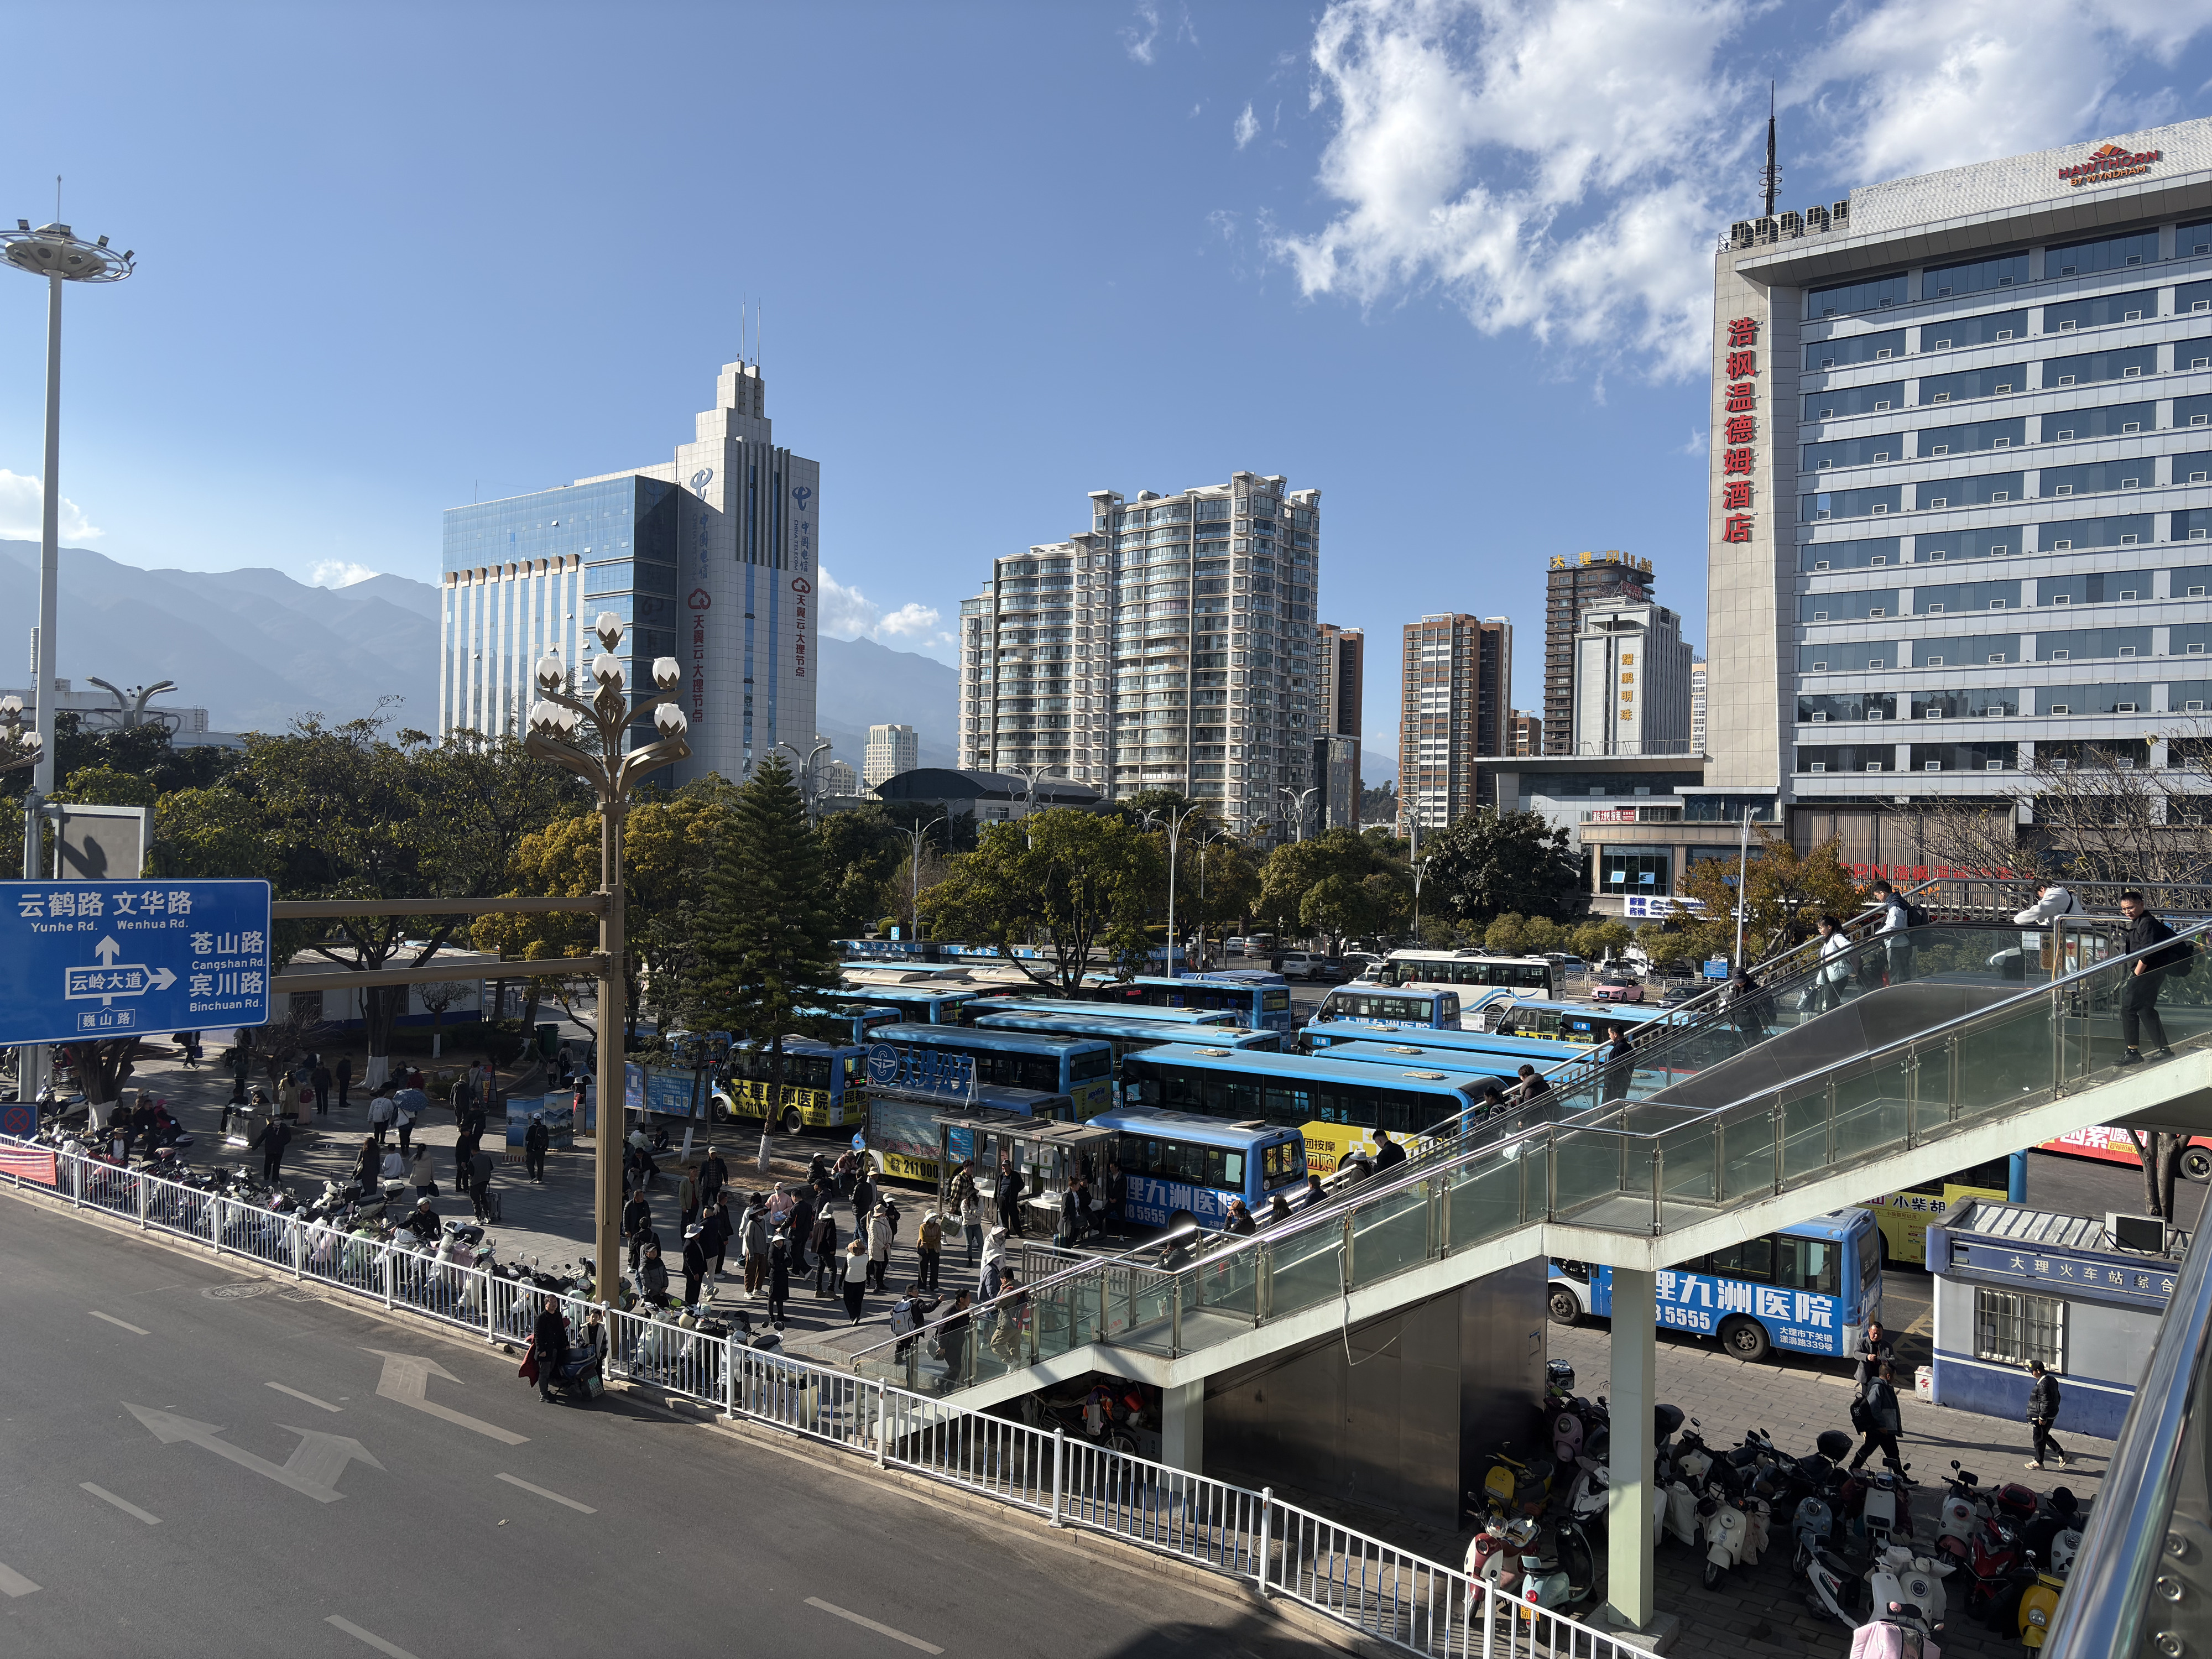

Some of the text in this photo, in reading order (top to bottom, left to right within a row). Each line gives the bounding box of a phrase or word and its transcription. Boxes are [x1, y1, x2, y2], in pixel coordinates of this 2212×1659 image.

[2059, 150, 2158, 179] HAWTHORN
[2070, 165, 2146, 186] BY WYNDHAM
[1722, 317, 1755, 542] 浩枫温德姆酒店
[1621, 653, 1634, 721] 耀鹏明珠
[18, 891, 192, 917] 云鹤路 文华路
[31, 919, 189, 932] Yunhe Rd. Wenhua Rd.
[190, 931, 264, 954] 苍山路
[192, 958, 265, 971] Cangshan Rd.
[71, 972, 142, 992] 云岭大道
[189, 972, 264, 997] 宾川路
[190, 999, 263, 1012] Binchuan Rd.
[83, 1013, 130, 1027] 巍山路
[901, 1045, 973, 1097] 大理公交
[745, 1102, 770, 1115] 21100
[1137, 1206, 1166, 1224] 5555
[1893, 1196, 1945, 1214] 小柴胡
[1665, 1306, 1710, 1329] 5555
[1780, 1326, 1833, 1343] 大理市下关镇
[1780, 1335, 1833, 1352] 漾濞路339号
